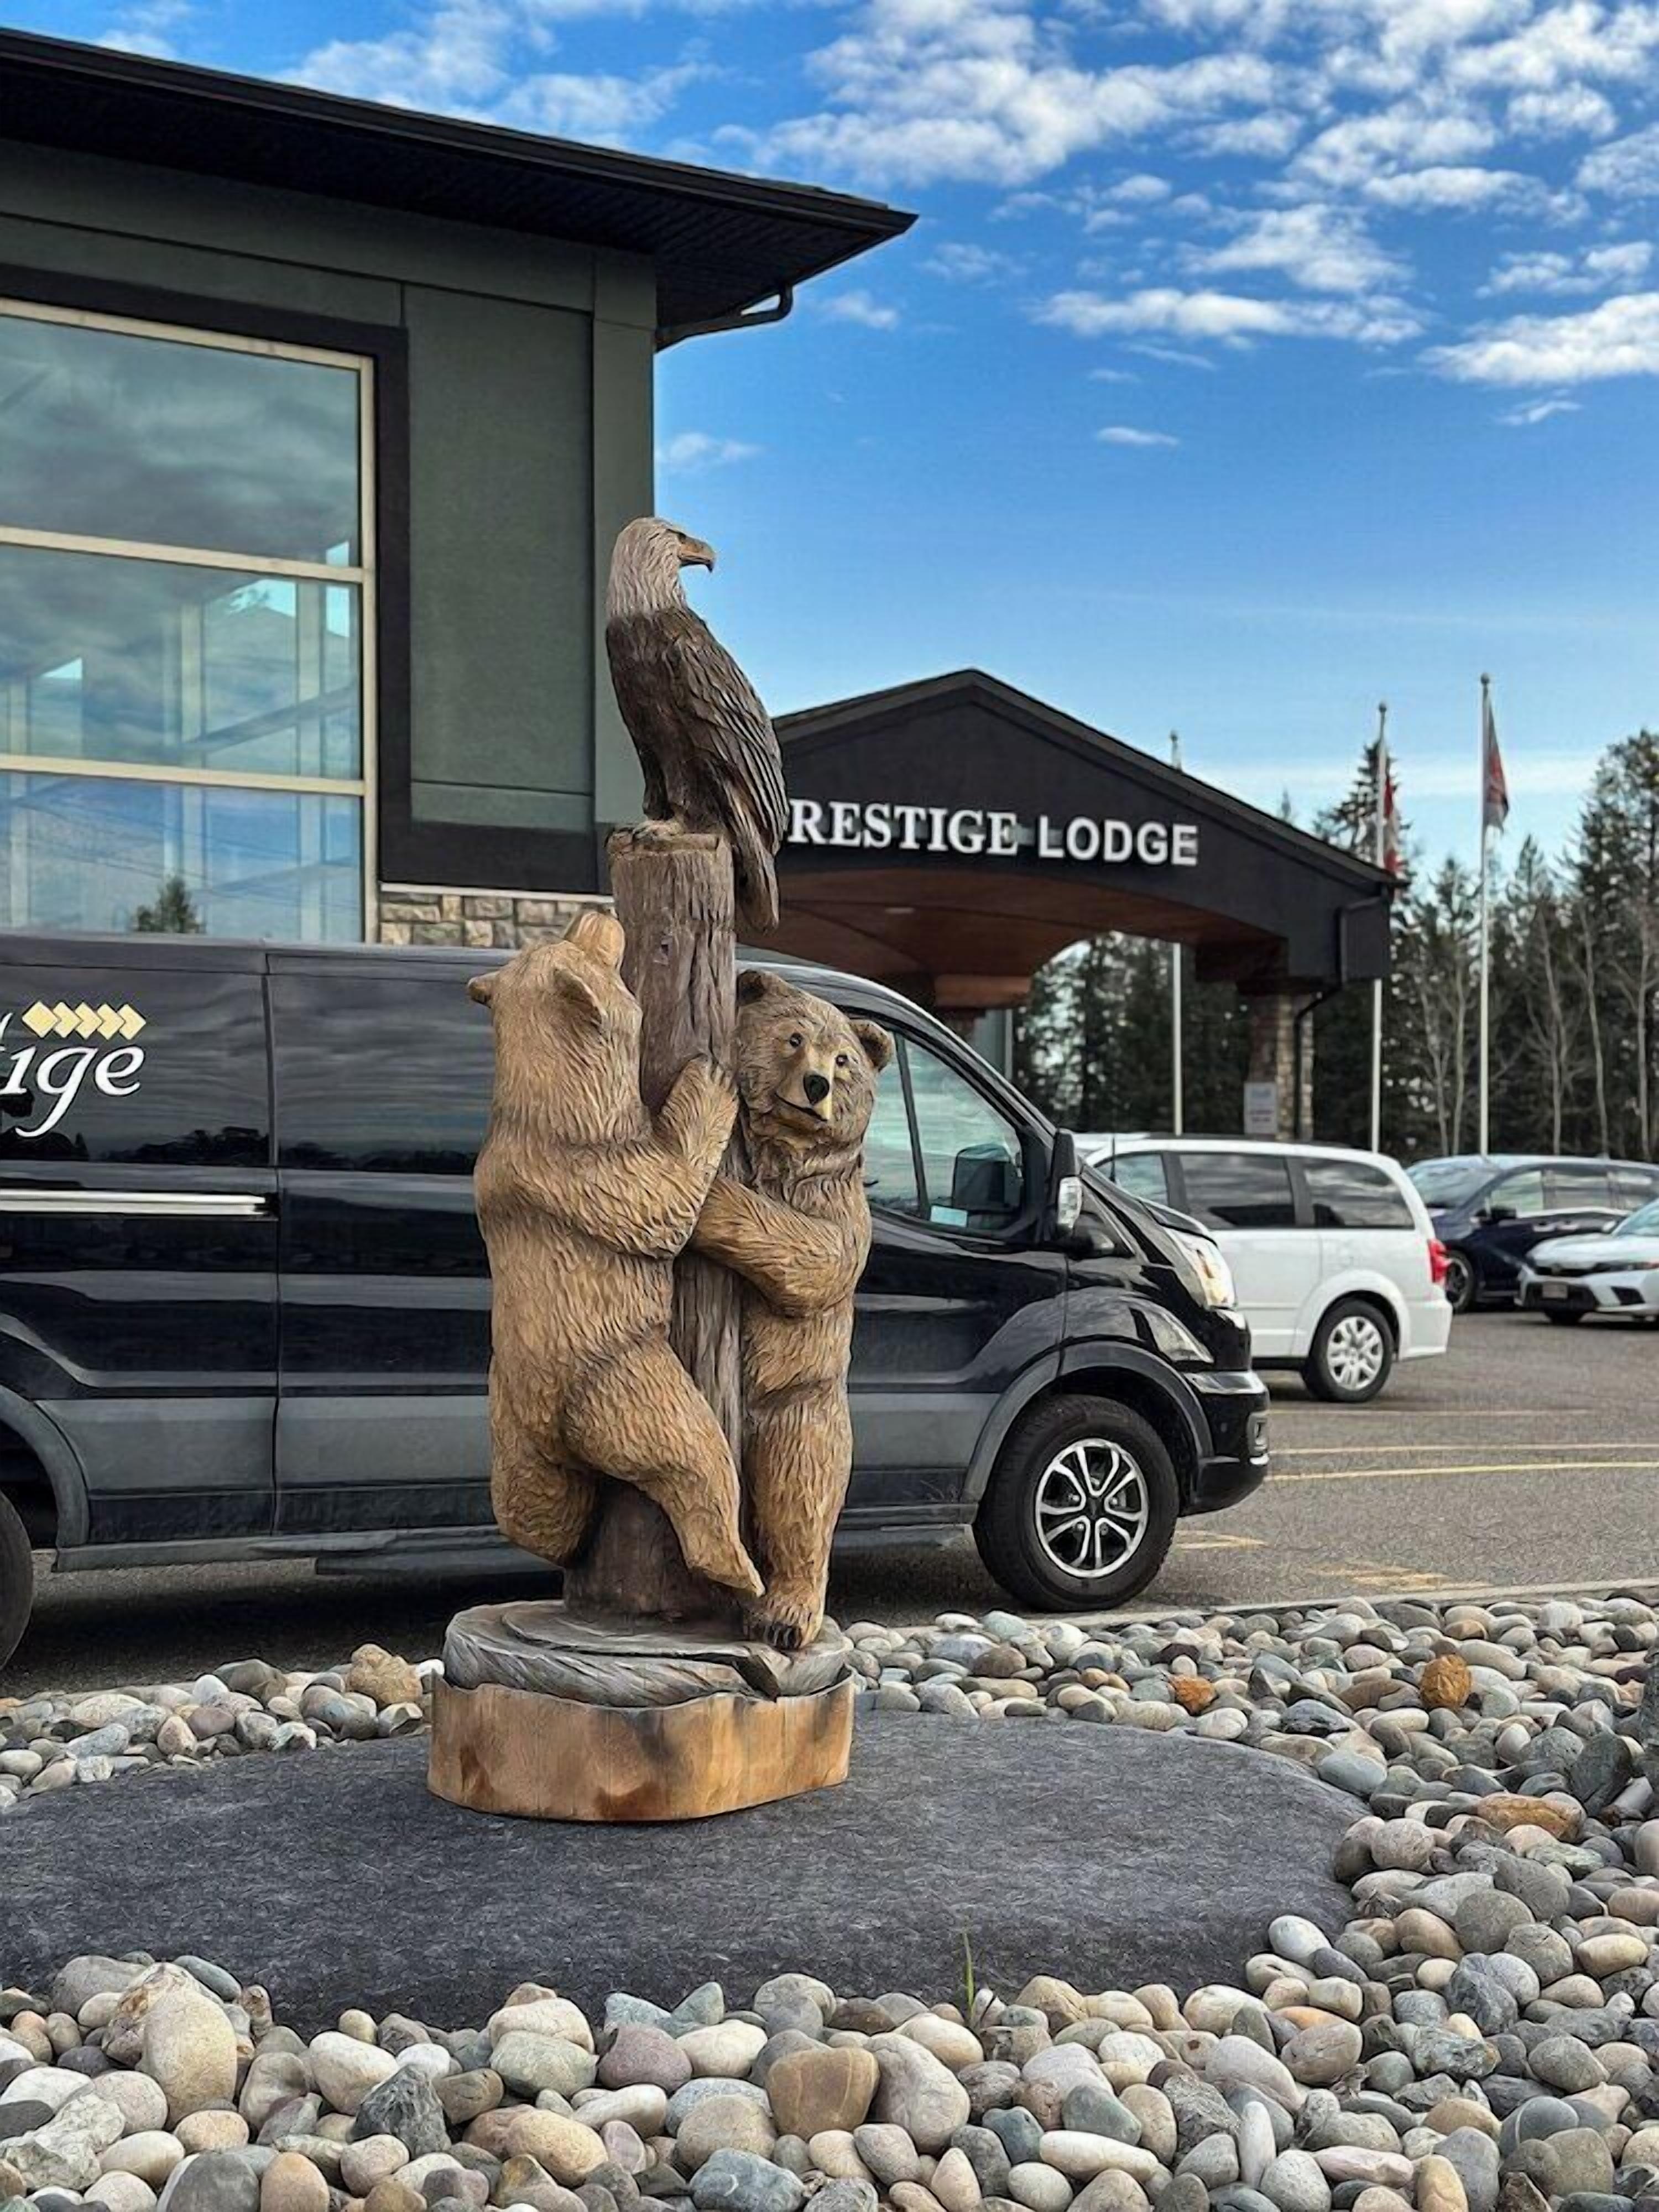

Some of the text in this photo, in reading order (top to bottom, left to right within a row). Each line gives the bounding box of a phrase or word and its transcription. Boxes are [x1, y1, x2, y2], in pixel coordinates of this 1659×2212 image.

[787, 798, 1198, 866] RESTIGE LODGE
[0, 1013, 145, 1137] ige
